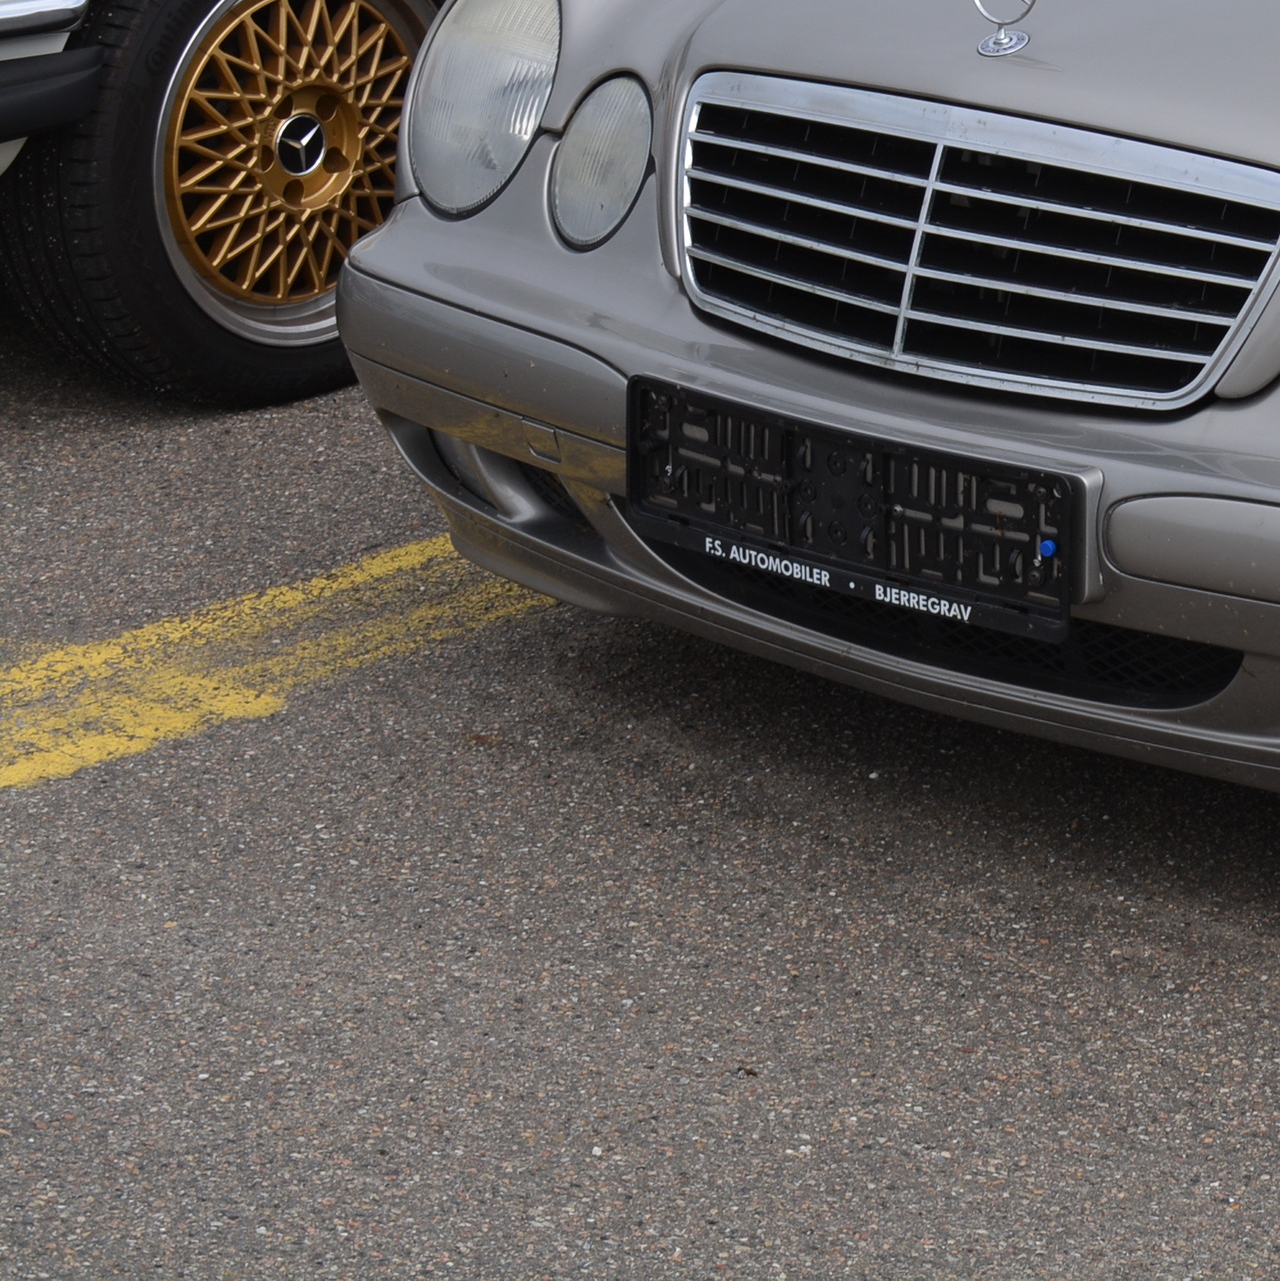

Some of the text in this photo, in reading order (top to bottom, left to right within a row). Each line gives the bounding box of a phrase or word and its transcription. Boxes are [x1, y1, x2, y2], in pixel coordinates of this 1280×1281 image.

[705, 537, 971, 621] F.S. AUTOMOBILER BJERREGRAV
